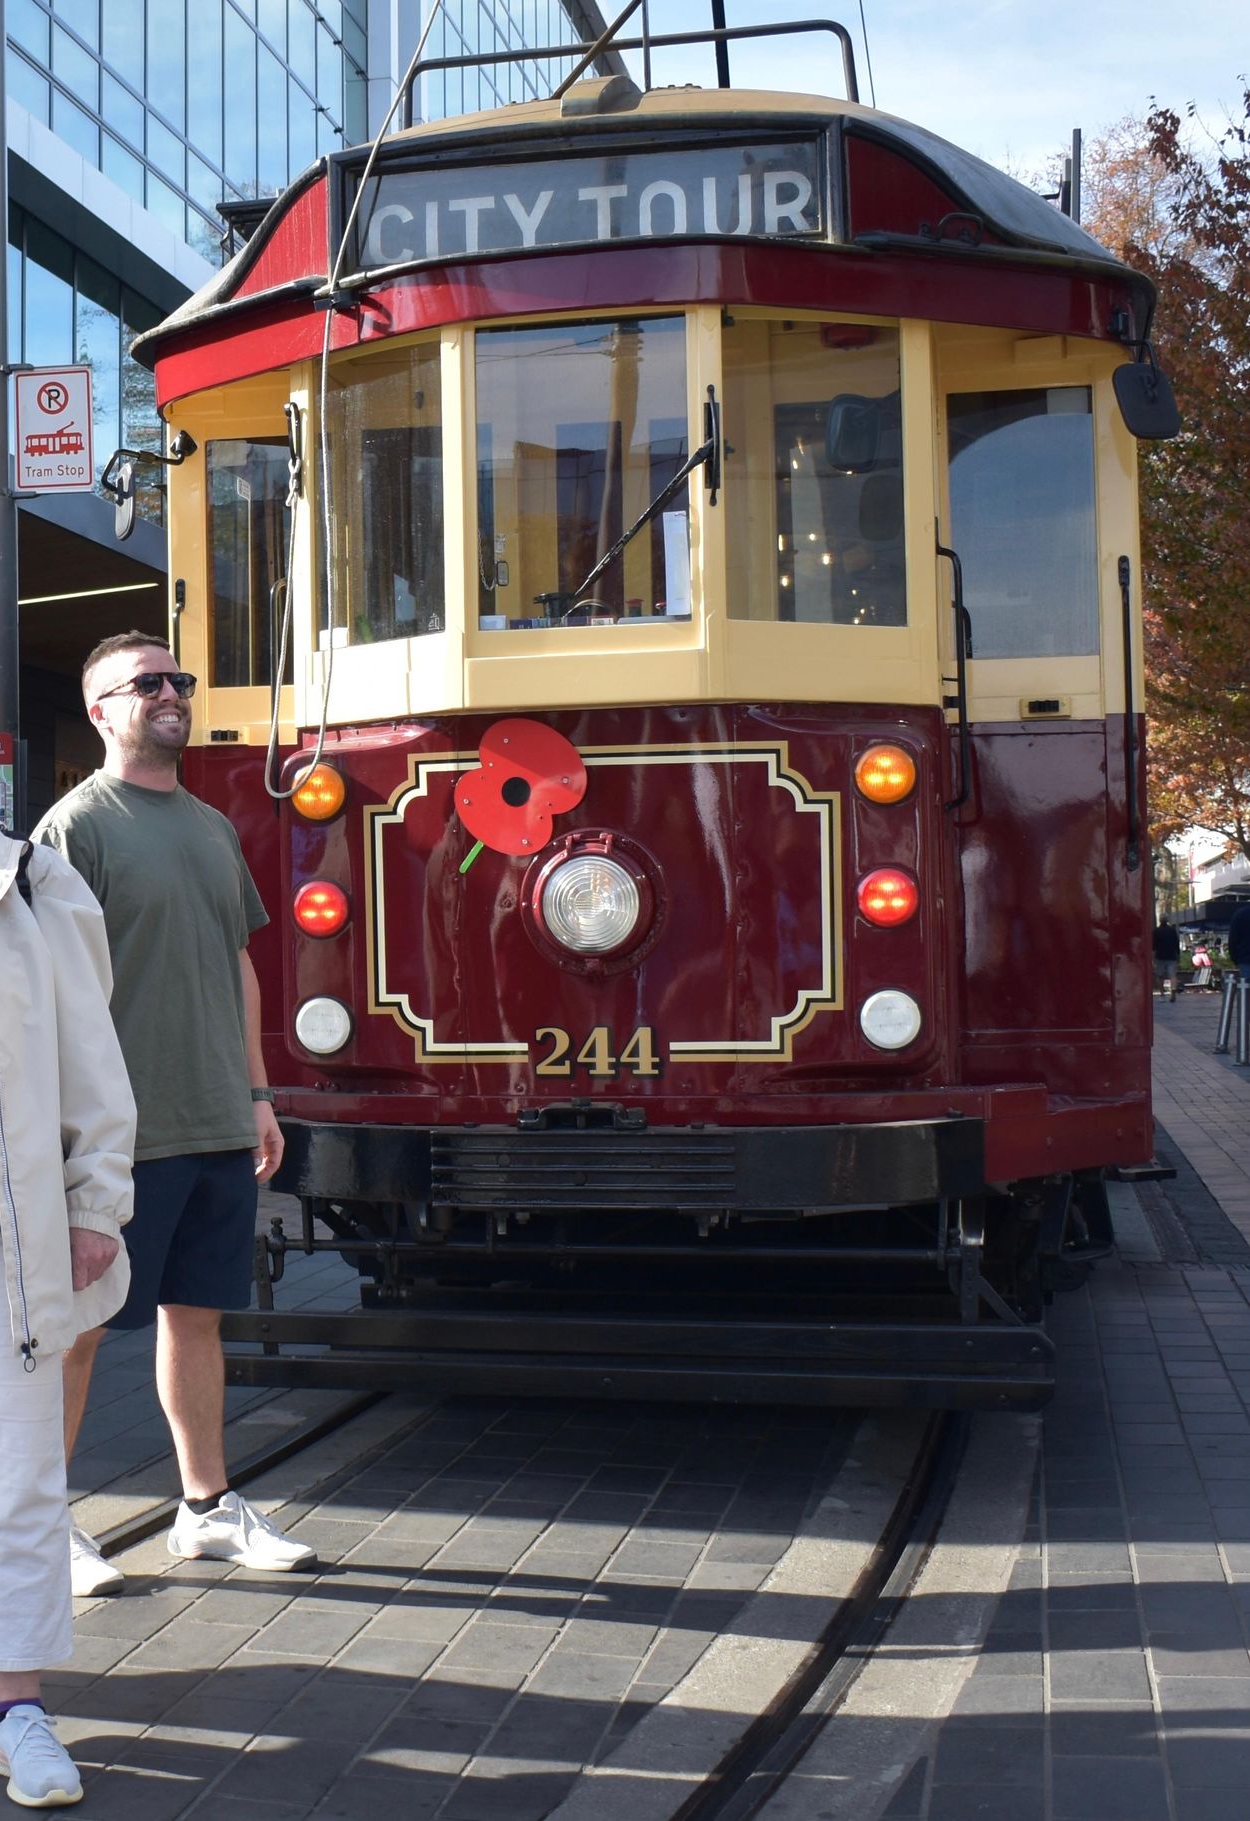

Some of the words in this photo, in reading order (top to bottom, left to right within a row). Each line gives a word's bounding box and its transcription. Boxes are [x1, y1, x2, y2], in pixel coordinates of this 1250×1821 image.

[366, 190, 554, 265] CITY
[578, 170, 812, 240] TOUR
[25, 465, 53, 478] Tram
[57, 464, 85, 478] Stop
[535, 1026, 660, 1075] 244
